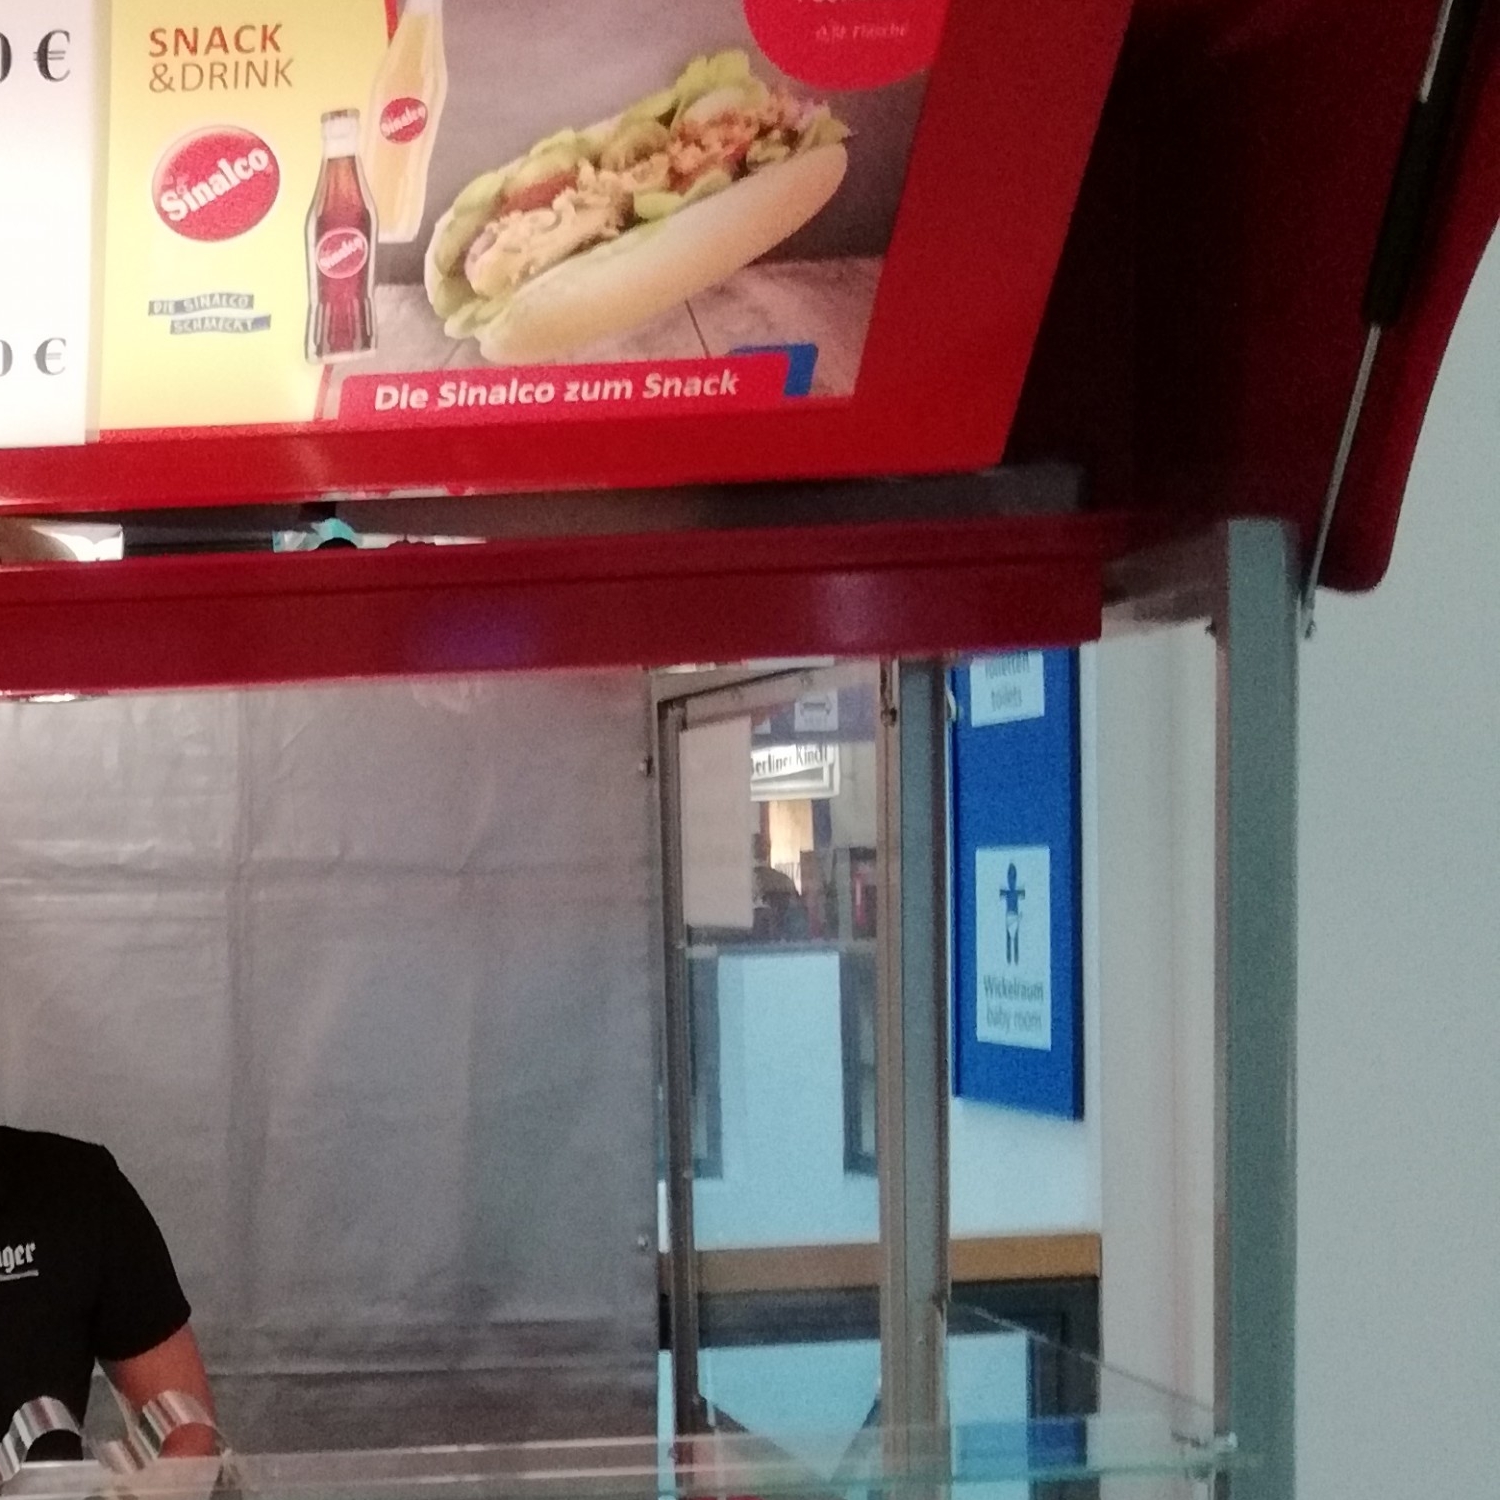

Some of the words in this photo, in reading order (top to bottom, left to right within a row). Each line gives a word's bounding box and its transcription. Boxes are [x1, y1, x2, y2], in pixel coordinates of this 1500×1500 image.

[33, 30, 71, 83] €
[149, 23, 283, 58] SNACK
[149, 58, 294, 93] &DRINK
[160, 147, 269, 222] Sinalco
[33, 337, 67, 377] €
[375, 383, 428, 411] Die
[438, 377, 555, 408] Sinalco
[565, 378, 633, 402] zum
[644, 369, 738, 398] Snack
